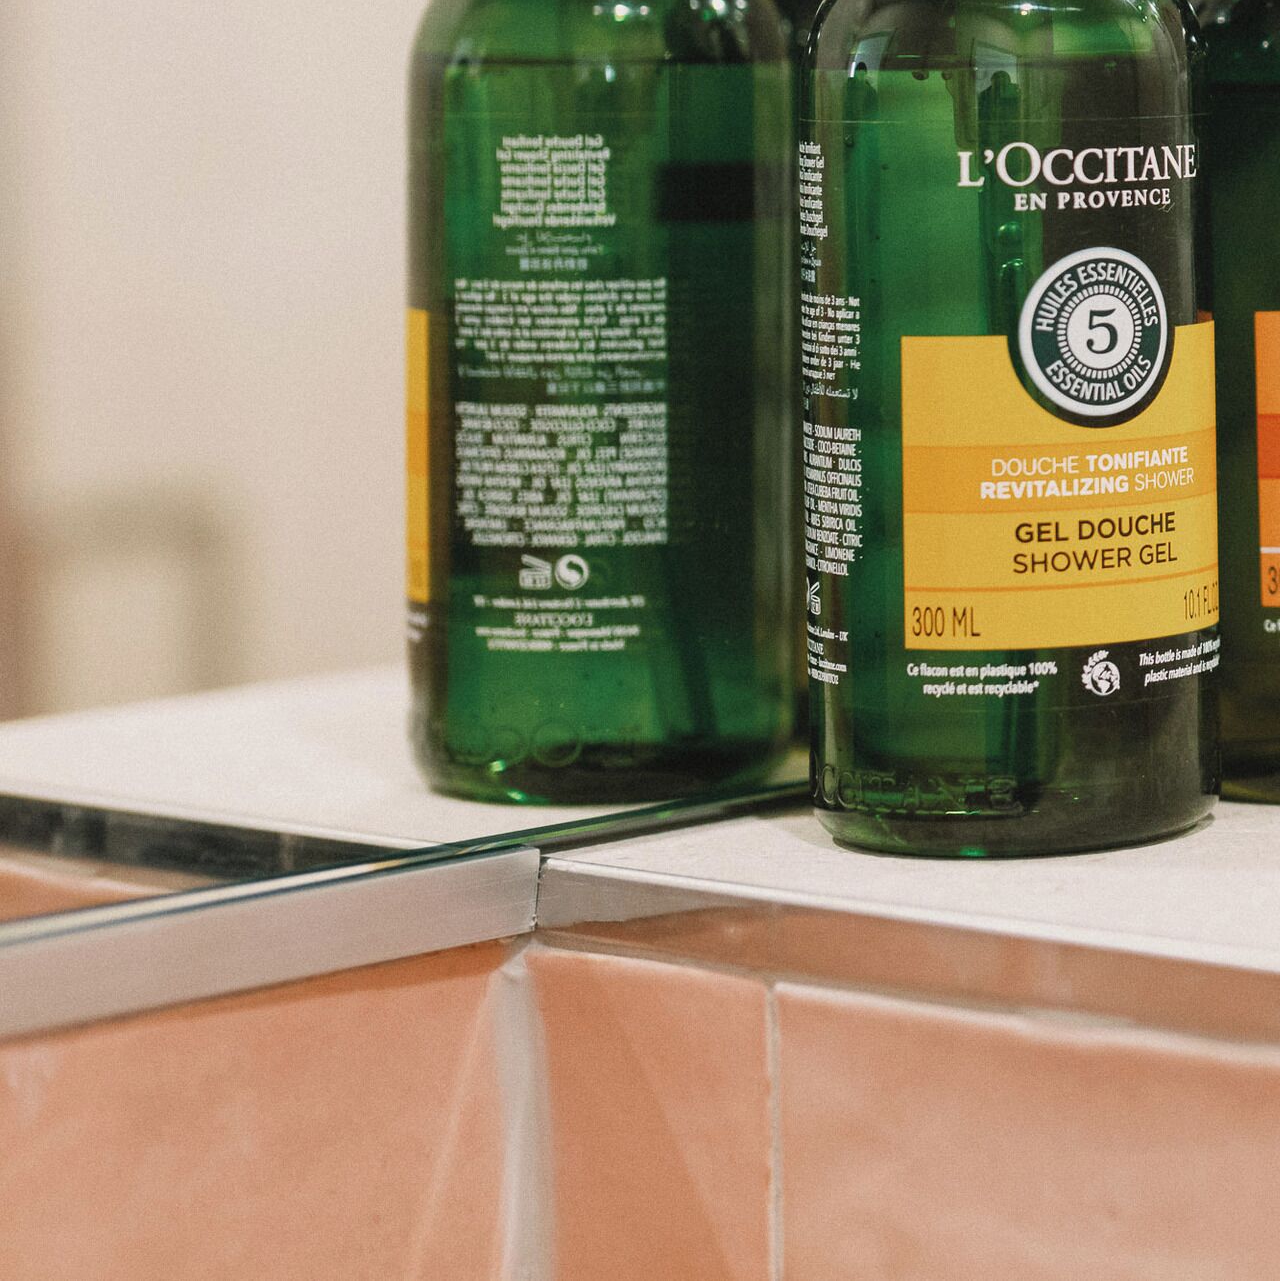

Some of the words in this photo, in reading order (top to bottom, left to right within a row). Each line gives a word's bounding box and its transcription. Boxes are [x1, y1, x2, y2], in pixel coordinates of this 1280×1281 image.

[957, 142, 1197, 188] L'OCCITANE
[1014, 192, 1047, 212] EN
[1058, 188, 1171, 210] PROVENCE
[1035, 273, 1079, 333] HUILES
[1077, 261, 1159, 328] ESSENTIELLES
[1086, 308, 1119, 354] 5
[1044, 357, 1125, 402] ESSENTIAL
[1124, 355, 1153, 392] OILS
[991, 456, 1079, 478] DOUCHE
[1086, 446, 1189, 472] TONIFIANTE
[980, 475, 1130, 500] REVITALIZING
[1134, 467, 1195, 492] SHOWER
[1014, 522, 1069, 544] GEL
[1078, 511, 1177, 541] DOUCHE
[1013, 550, 1132, 574] SHOWER
[1139, 541, 1178, 565] GEL
[1184, 588, 1201, 620] 10.1
[911, 606, 945, 638] 300
[952, 605, 982, 638] ML
[906, 663, 919, 677] Ce
[920, 662, 948, 677] flacon
[949, 665, 965, 677] est
[965, 666, 979, 677] en
[979, 664, 1027, 680] plastique
[1028, 661, 1058, 676] 100%
[1139, 652, 1155, 666] This
[1155, 648, 1175, 665] bottle
[1175, 648, 1182, 661] is
[1182, 644, 1197, 659] made
[1197, 642, 1203, 656] of
[923, 681, 955, 698] recyclé
[956, 683, 967, 695] et
[967, 683, 984, 695] est
[1144, 668, 1169, 687] plastic
[1168, 662, 1193, 679] material
[1193, 660, 1202, 674] and
